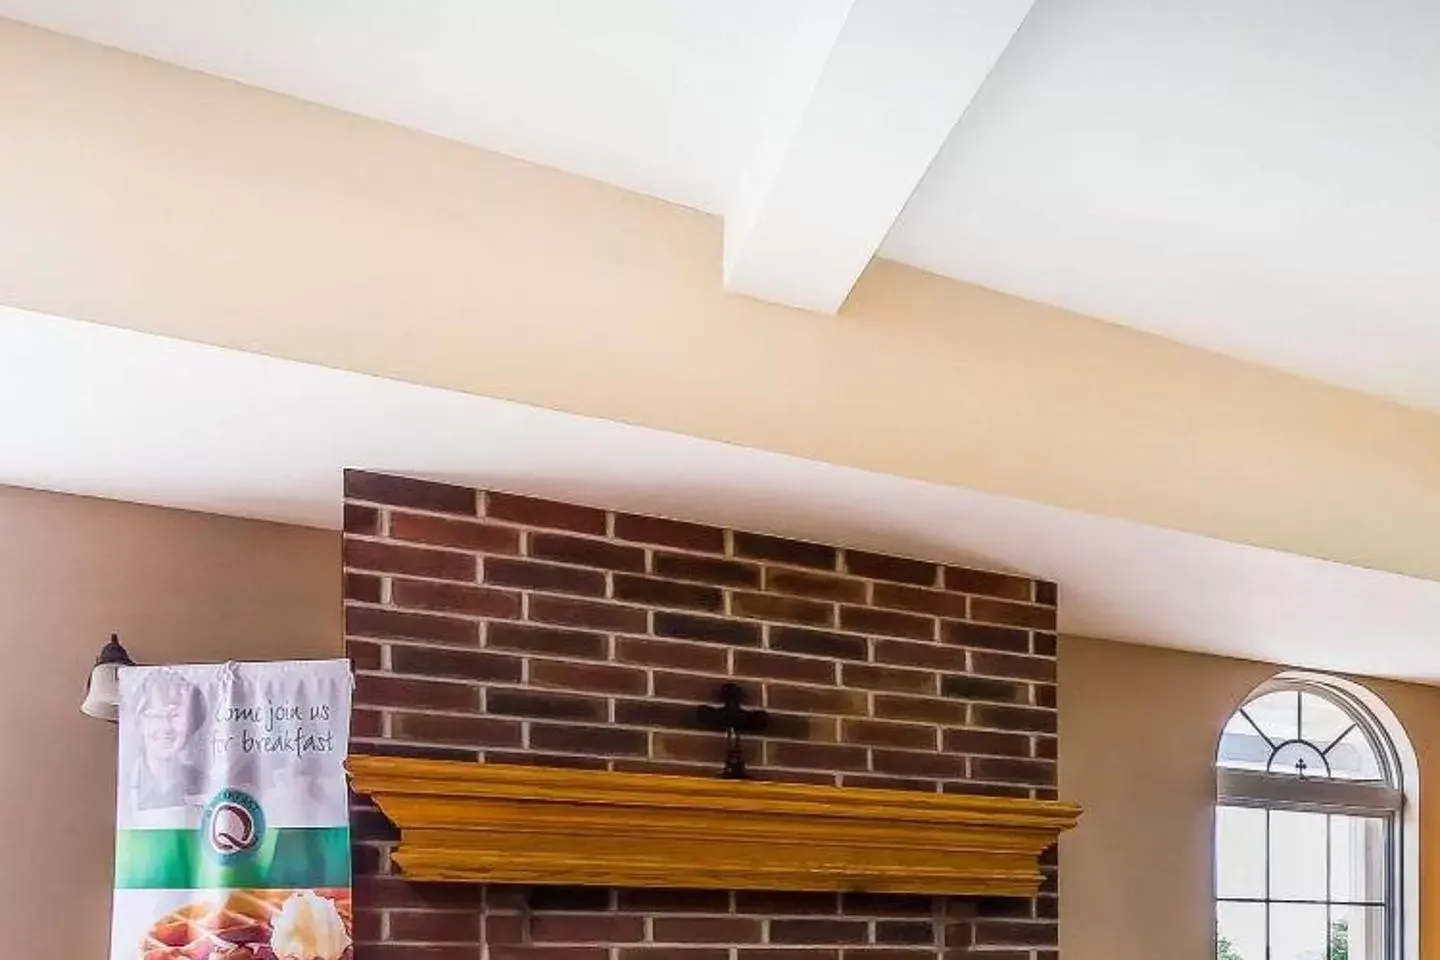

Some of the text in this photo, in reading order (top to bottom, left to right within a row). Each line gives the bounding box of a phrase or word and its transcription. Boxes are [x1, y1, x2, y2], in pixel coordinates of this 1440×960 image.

[264, 699, 303, 732] join
[309, 704, 330, 721] us
[242, 726, 334, 759] breakfast
